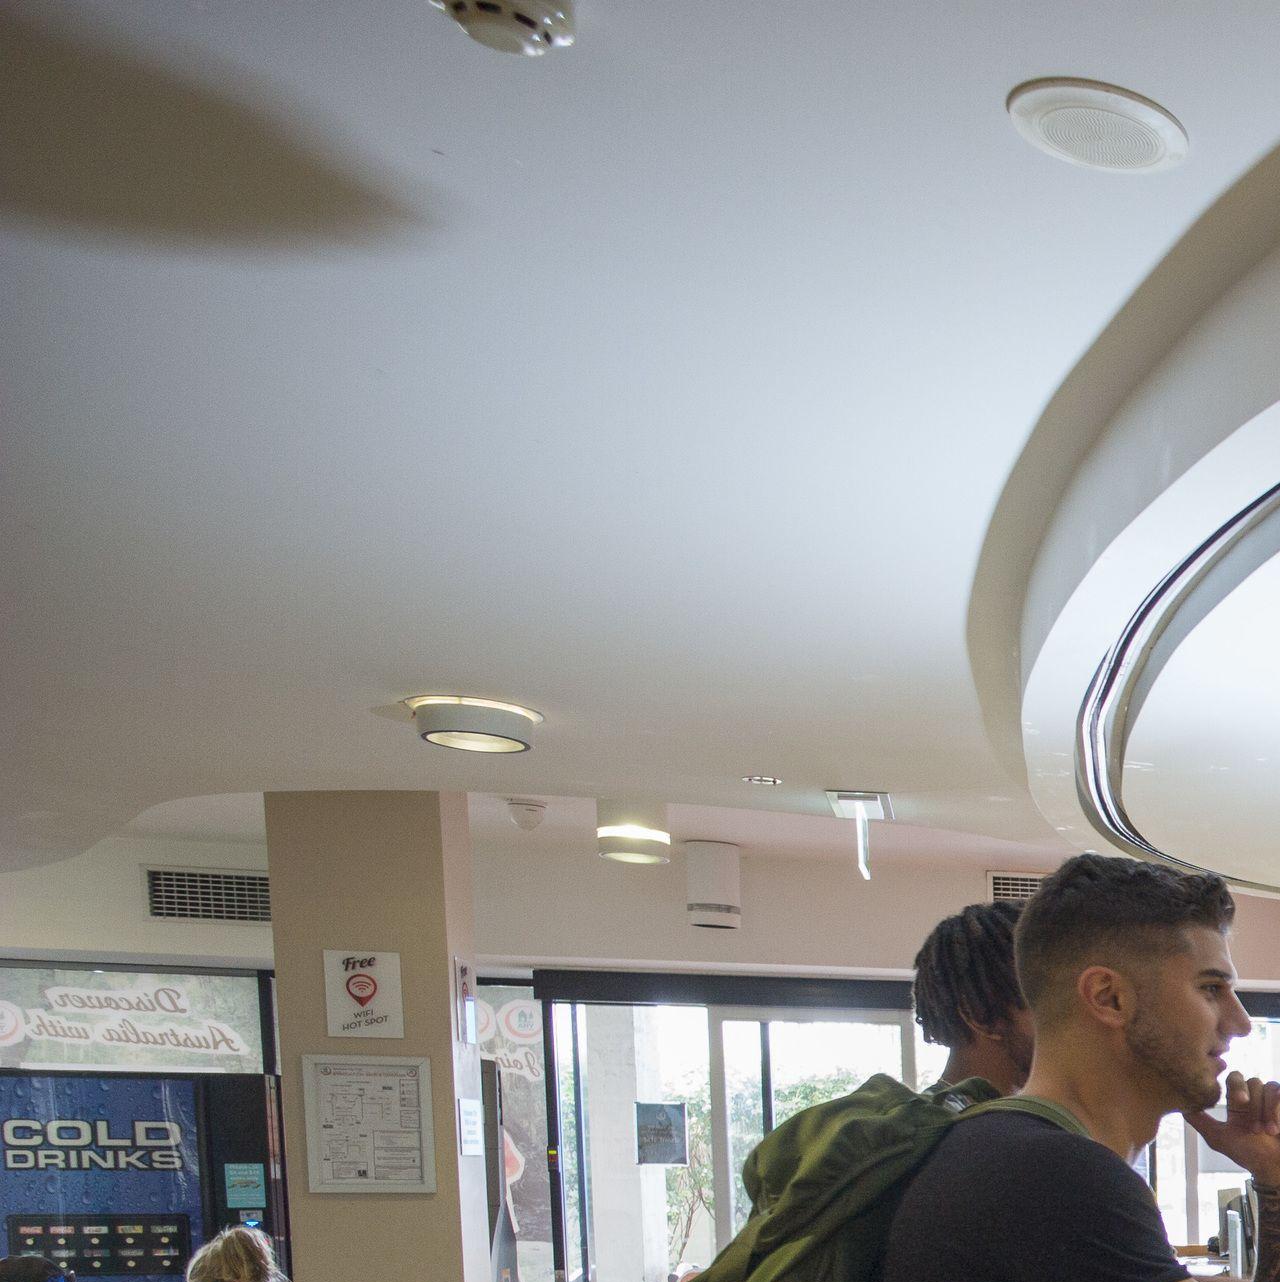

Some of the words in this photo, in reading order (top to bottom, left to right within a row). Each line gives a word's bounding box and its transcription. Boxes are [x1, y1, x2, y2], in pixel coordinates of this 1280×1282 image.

[342, 956, 377, 972] Free
[342, 1021, 363, 1031] HOT
[364, 1015, 390, 1028] SPOT
[3, 1119, 183, 1147] COLD
[6, 1150, 183, 1169] DRINKS
